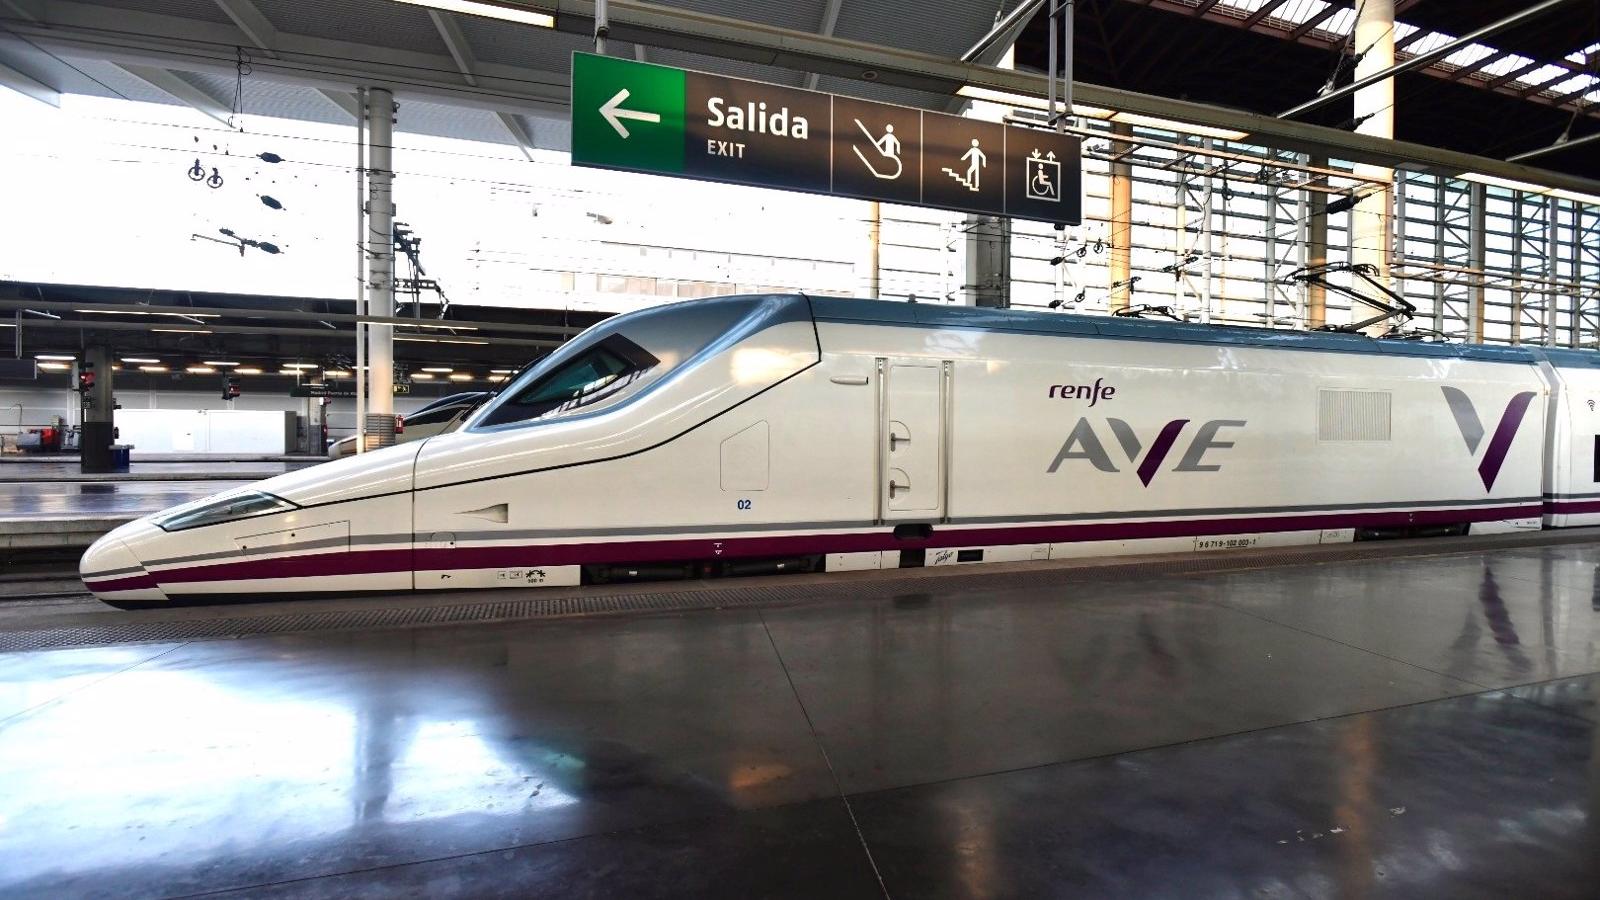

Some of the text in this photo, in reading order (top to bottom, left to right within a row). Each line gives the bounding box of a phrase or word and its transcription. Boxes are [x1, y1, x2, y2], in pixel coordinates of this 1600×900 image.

[707, 97, 809, 140] Salida
[707, 139, 746, 159] EXIT
[1049, 377, 1116, 408] renfe
[1046, 416, 1248, 489] AVE
[737, 499, 752, 510] 02
